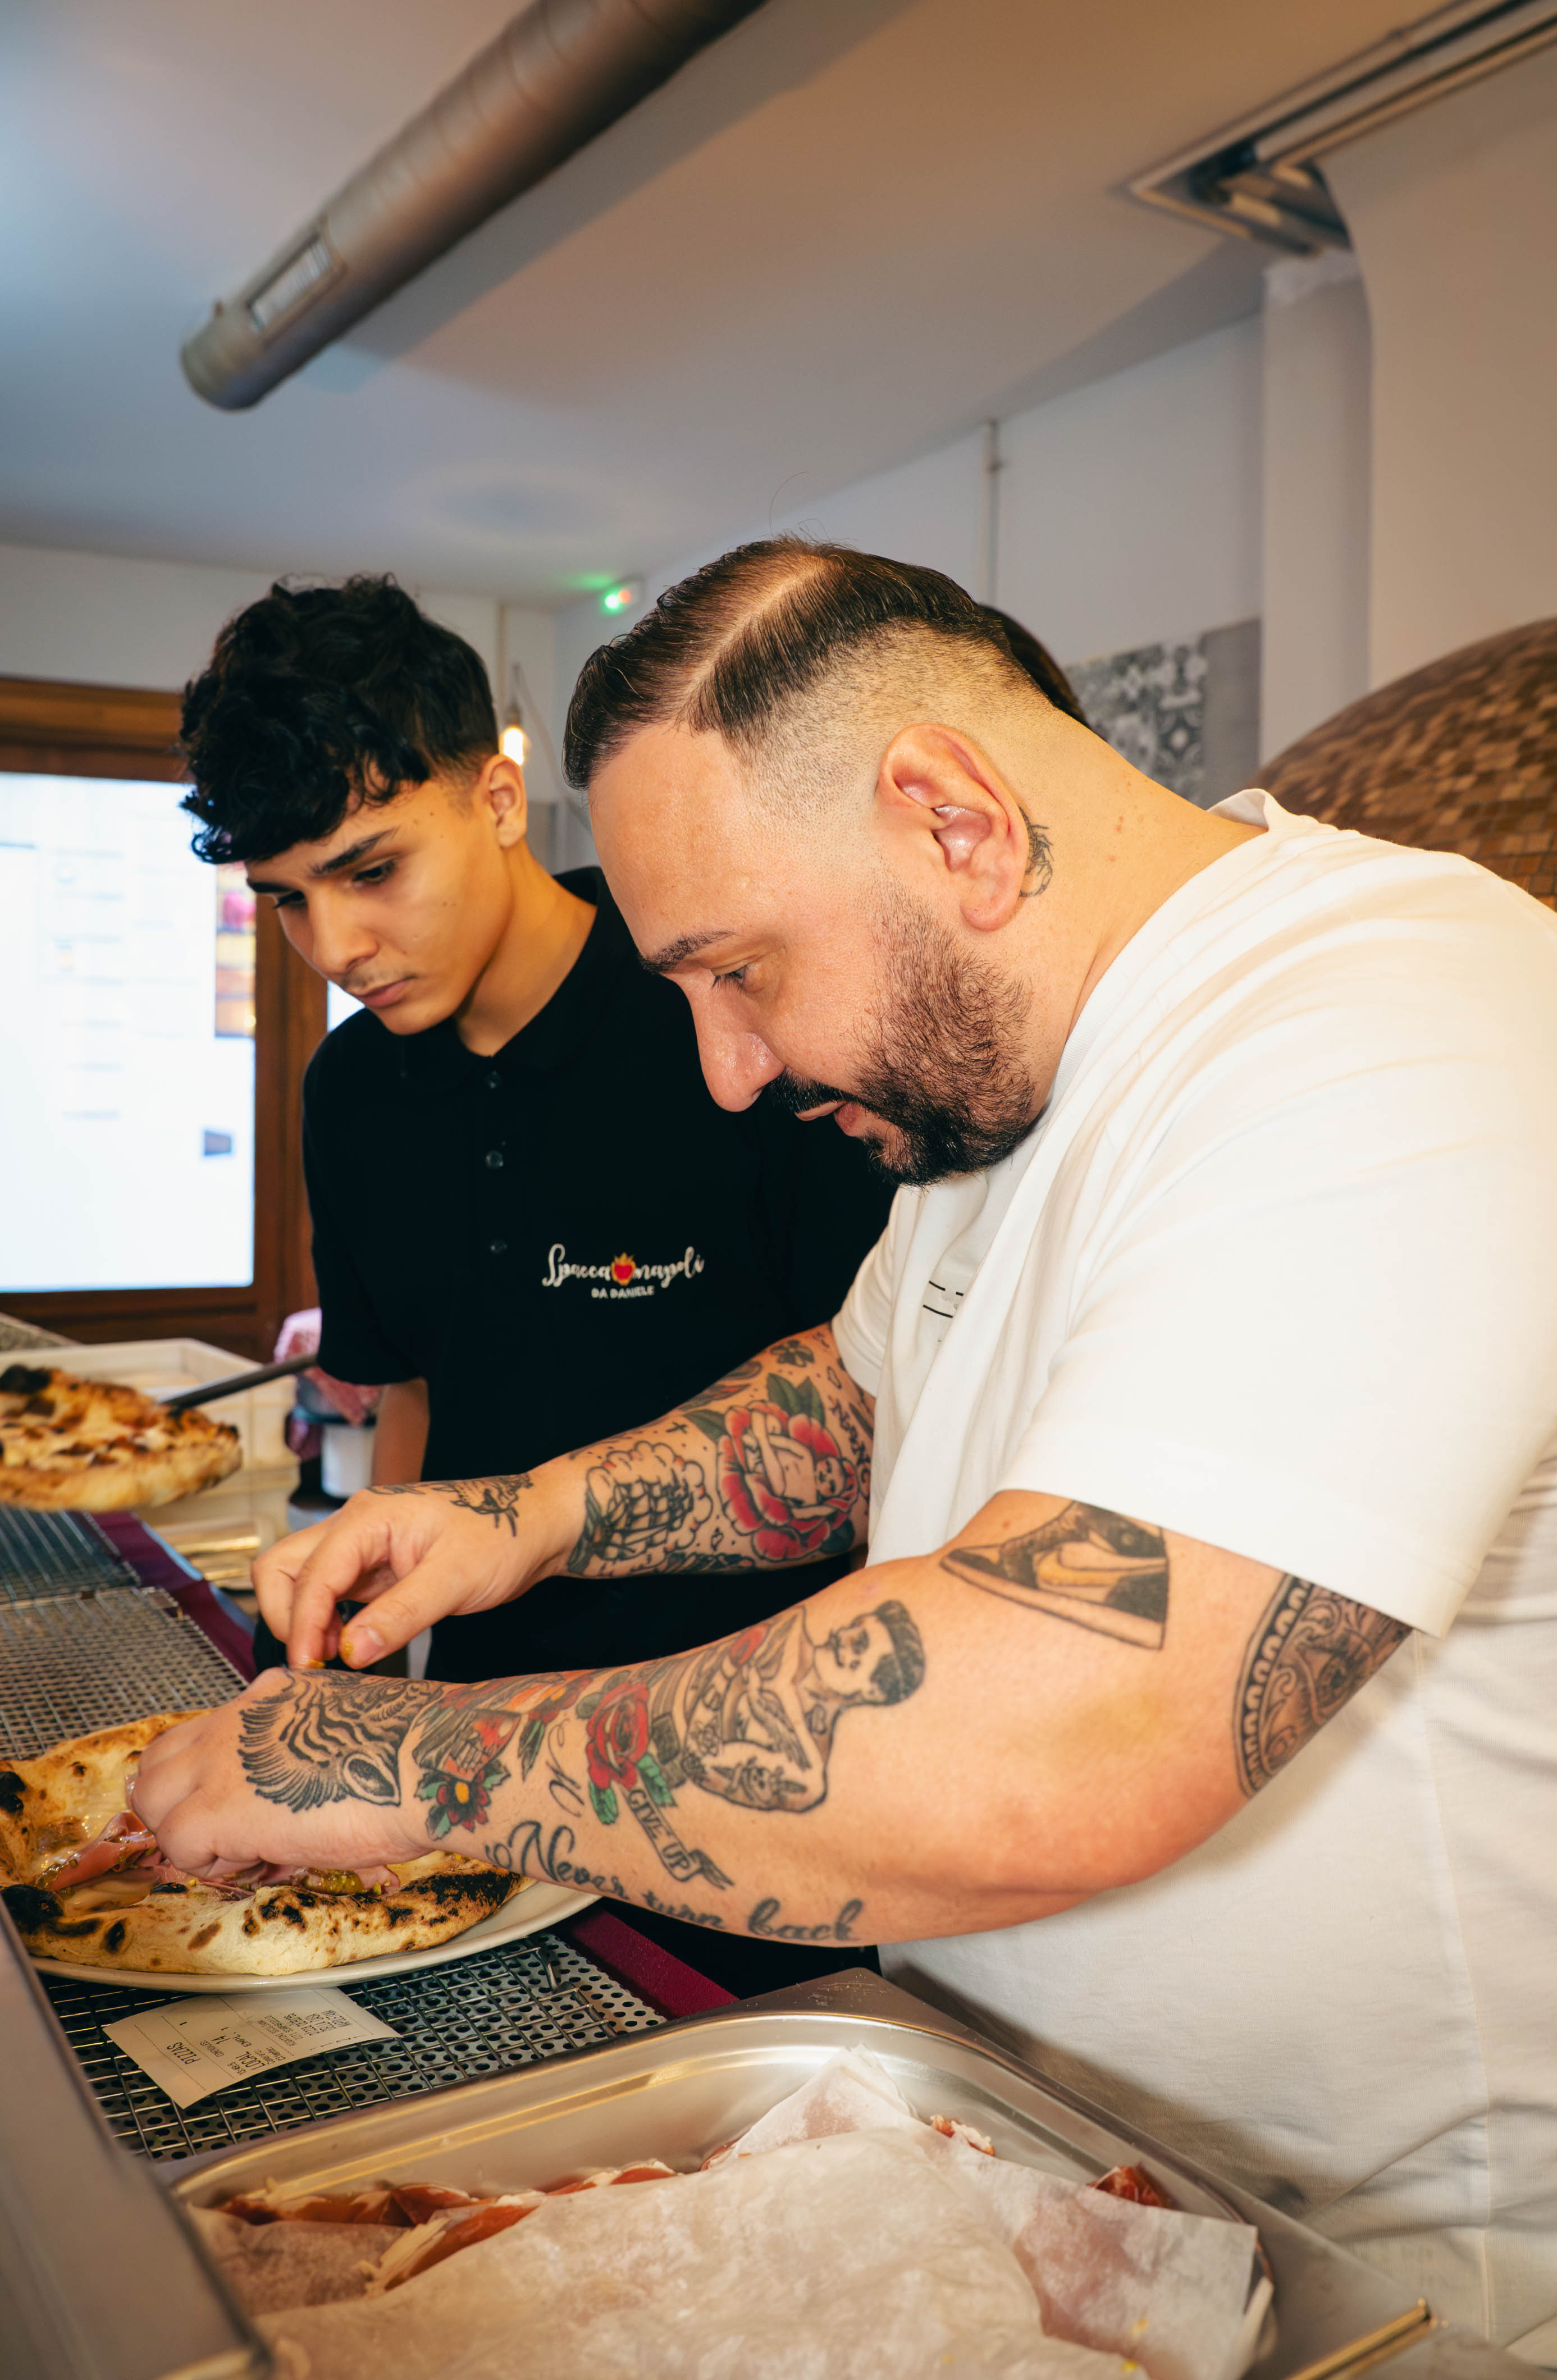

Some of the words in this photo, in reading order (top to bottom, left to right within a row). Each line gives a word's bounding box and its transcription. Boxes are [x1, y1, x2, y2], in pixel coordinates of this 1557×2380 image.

[591, 1287, 608, 1298] DA
[610, 1285, 654, 1298] DANIELE
[628, 1788, 673, 1839] GIVE
[662, 1842, 691, 1870] UP
[485, 1820, 629, 1900] Never
[211, 2035, 230, 2044] 14
[232, 2032, 252, 2047] EMPL.
[167, 2042, 202, 2065] PIZZAS
[235, 2051, 266, 2071] LOCAL
[266, 2047, 286, 2061] Cliente:
